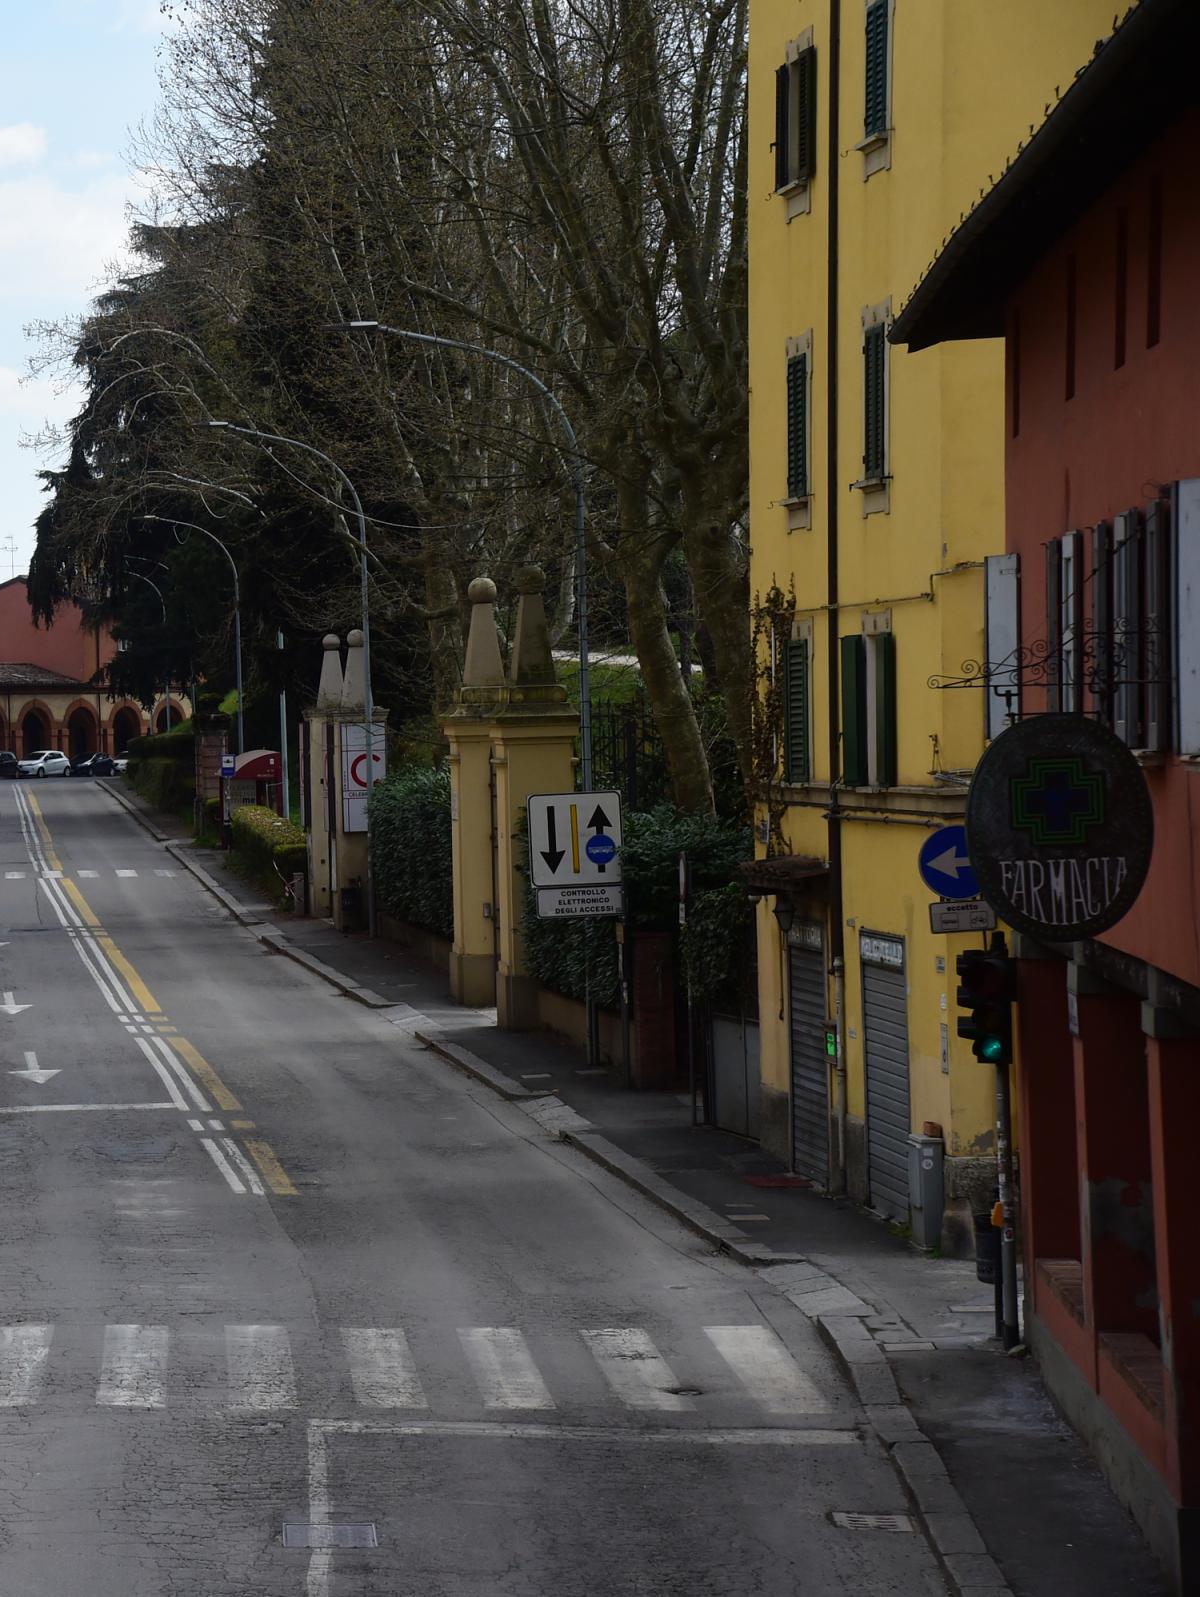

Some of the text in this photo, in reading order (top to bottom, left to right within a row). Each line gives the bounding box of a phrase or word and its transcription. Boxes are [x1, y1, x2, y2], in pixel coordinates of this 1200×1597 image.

[560, 888, 606, 897] CONTROLLO
[999, 856, 1128, 926] FARMACIA
[558, 897, 610, 906] ELETTRONICO
[580, 905, 614, 913] ACCESSI
[947, 904, 979, 912] eccetto
